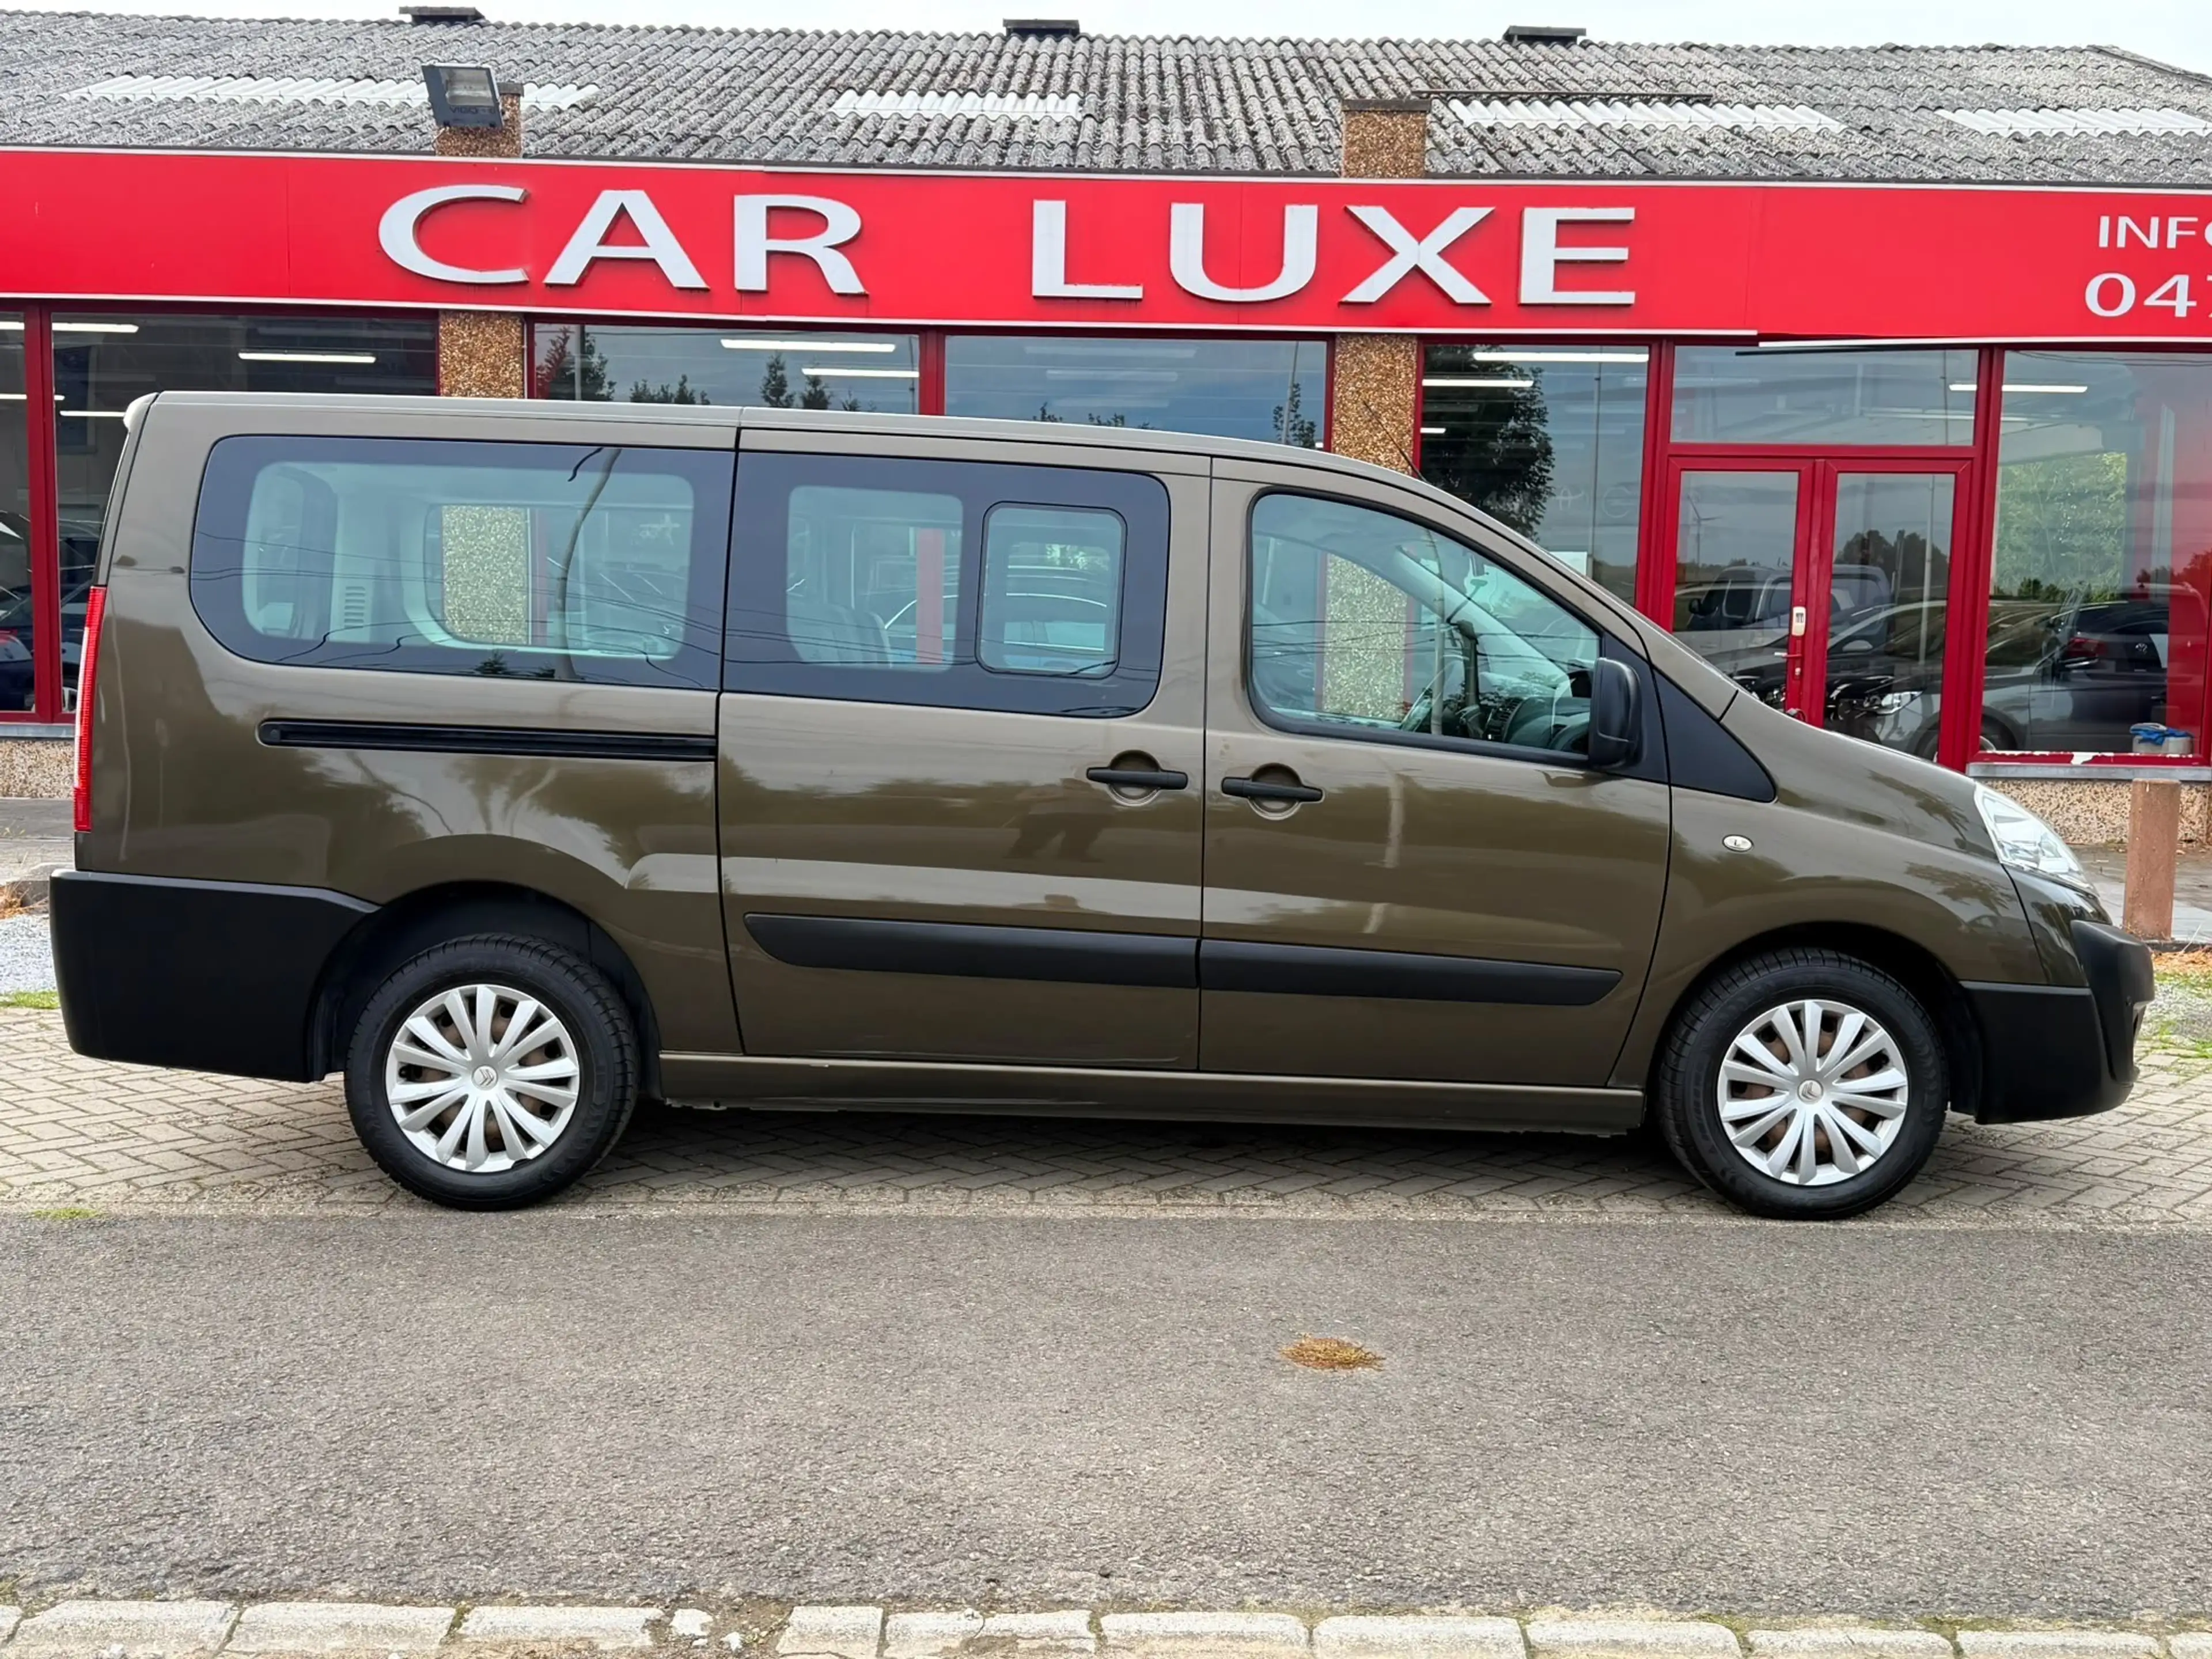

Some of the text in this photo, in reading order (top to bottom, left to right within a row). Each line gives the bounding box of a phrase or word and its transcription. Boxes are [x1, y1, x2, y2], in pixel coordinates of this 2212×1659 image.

[378, 184, 1637, 305] CAR LUXE
[2099, 215, 2212, 249] INF
[2085, 272, 2212, 317] 04
